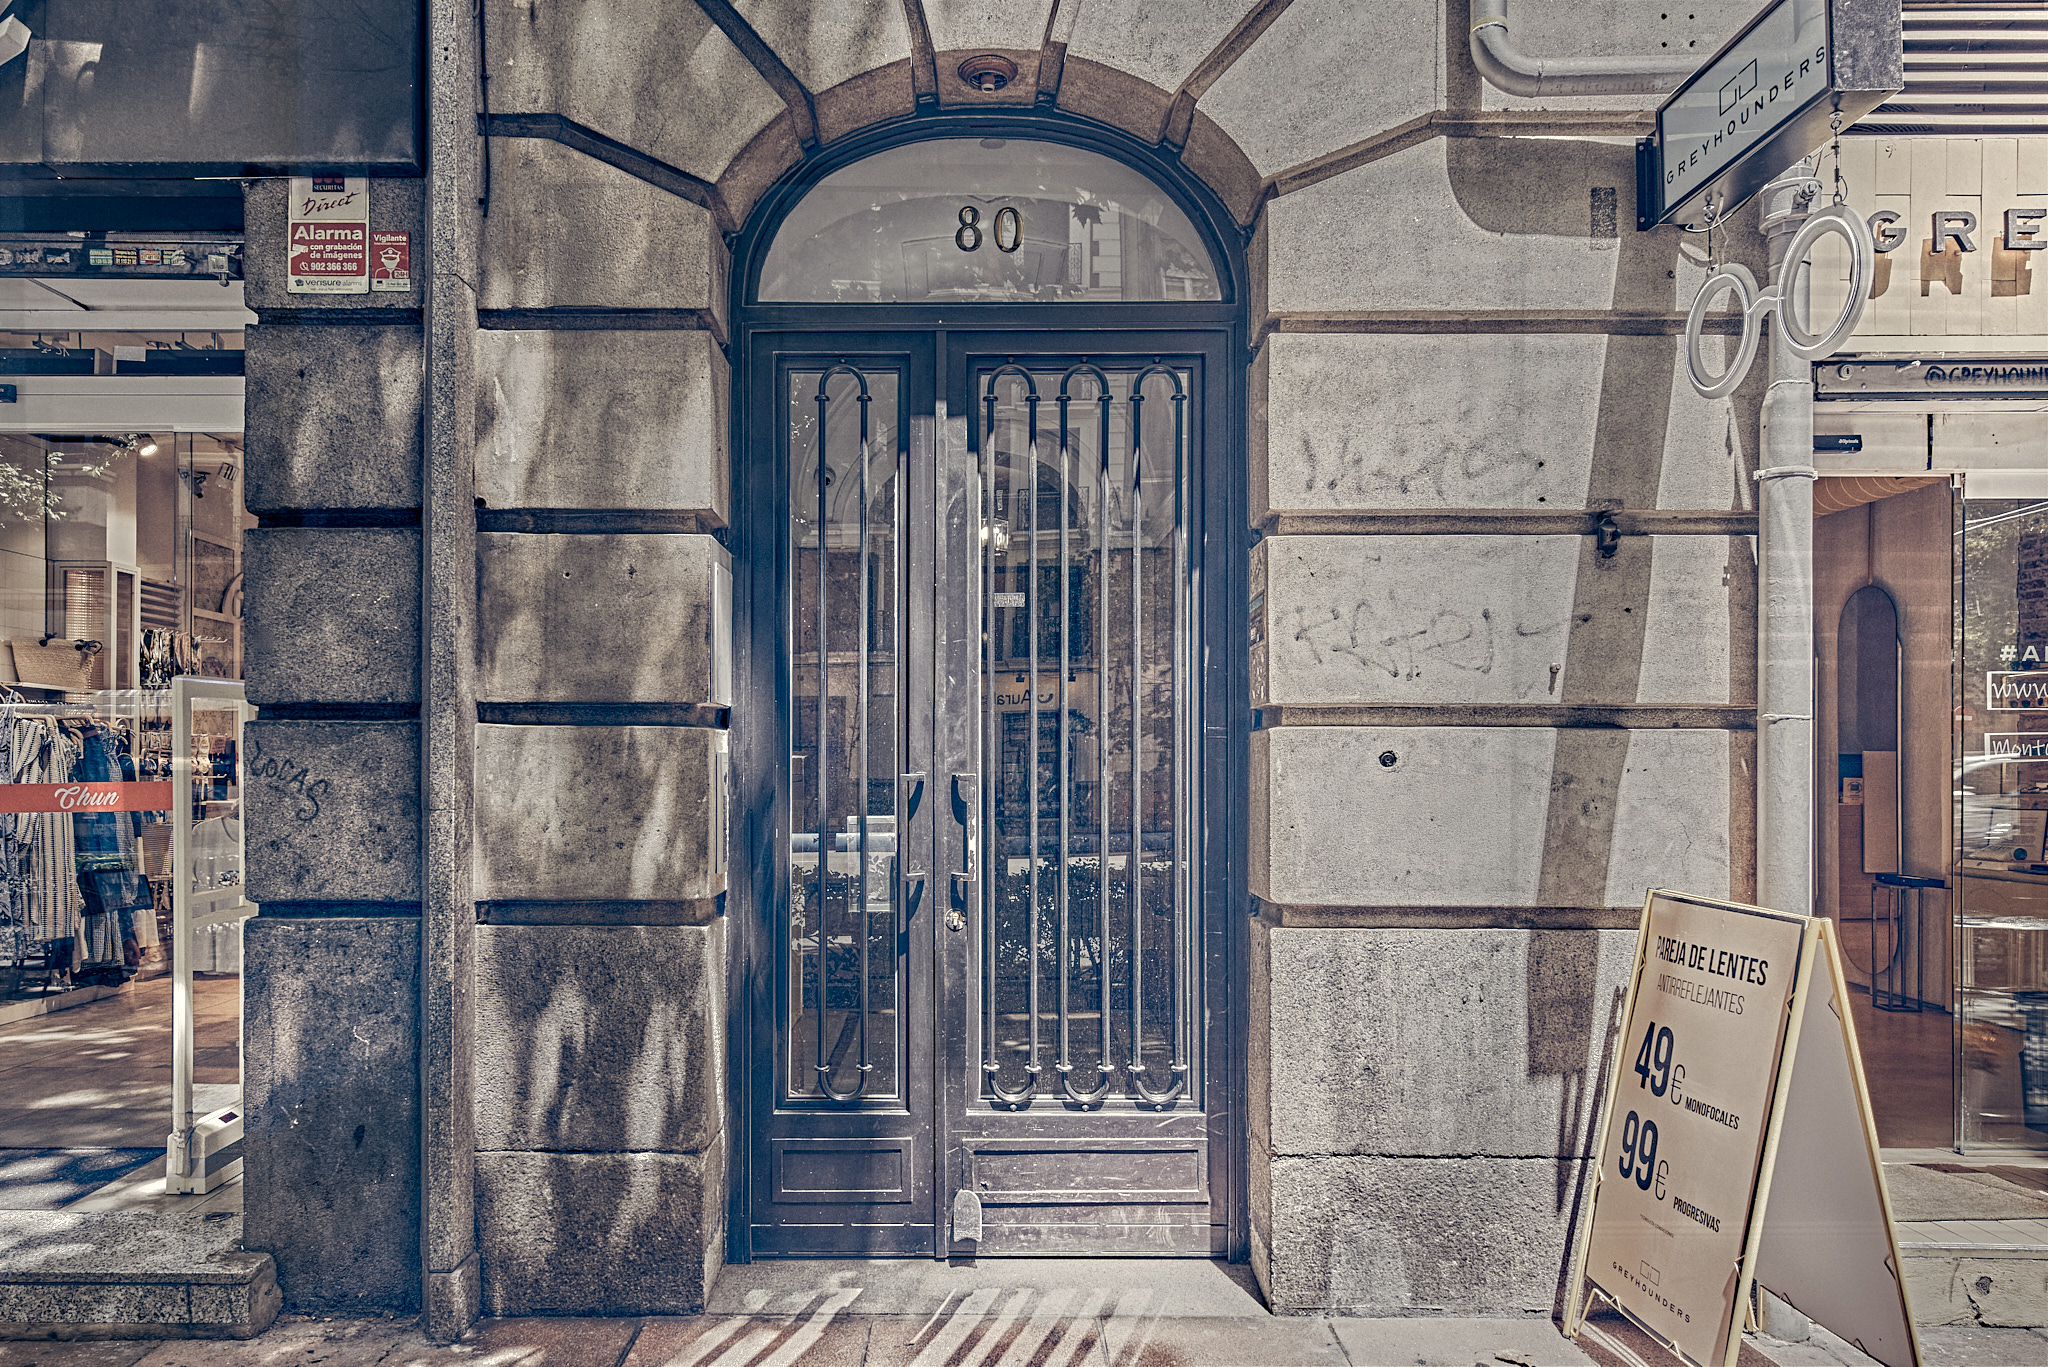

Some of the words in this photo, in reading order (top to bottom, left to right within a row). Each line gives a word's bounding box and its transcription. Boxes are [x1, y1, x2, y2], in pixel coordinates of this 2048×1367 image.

[1666, 46, 1825, 185] GREYHOUNDERS
[302, 192, 360, 216] Direct
[293, 224, 363, 240] Alarma
[373, 234, 407, 243] Vigilante
[955, 205, 1024, 253] 80
[310, 251, 321, 259] de
[323, 250, 363, 260] imágenes
[325, 242, 363, 253] grabación
[310, 262, 326, 271] 902
[326, 262, 341, 271] 366
[342, 262, 358, 271] 366
[305, 279, 342, 287] verisure
[1992, 738, 2048, 757] Mont
[54, 785, 120, 810] Chun
[1655, 935, 1687, 967] PAREJA
[1688, 943, 1708, 971] DE
[1708, 948, 1769, 986] LENTES
[1656, 973, 1745, 1015] ANTIRREFLEJANTES
[1684, 1096, 1740, 1130] MONOFOCALES
[1672, 1196, 1721, 1234] PROGRESIVAS
[1612, 1261, 1691, 1324] GREYHOUNDERS
